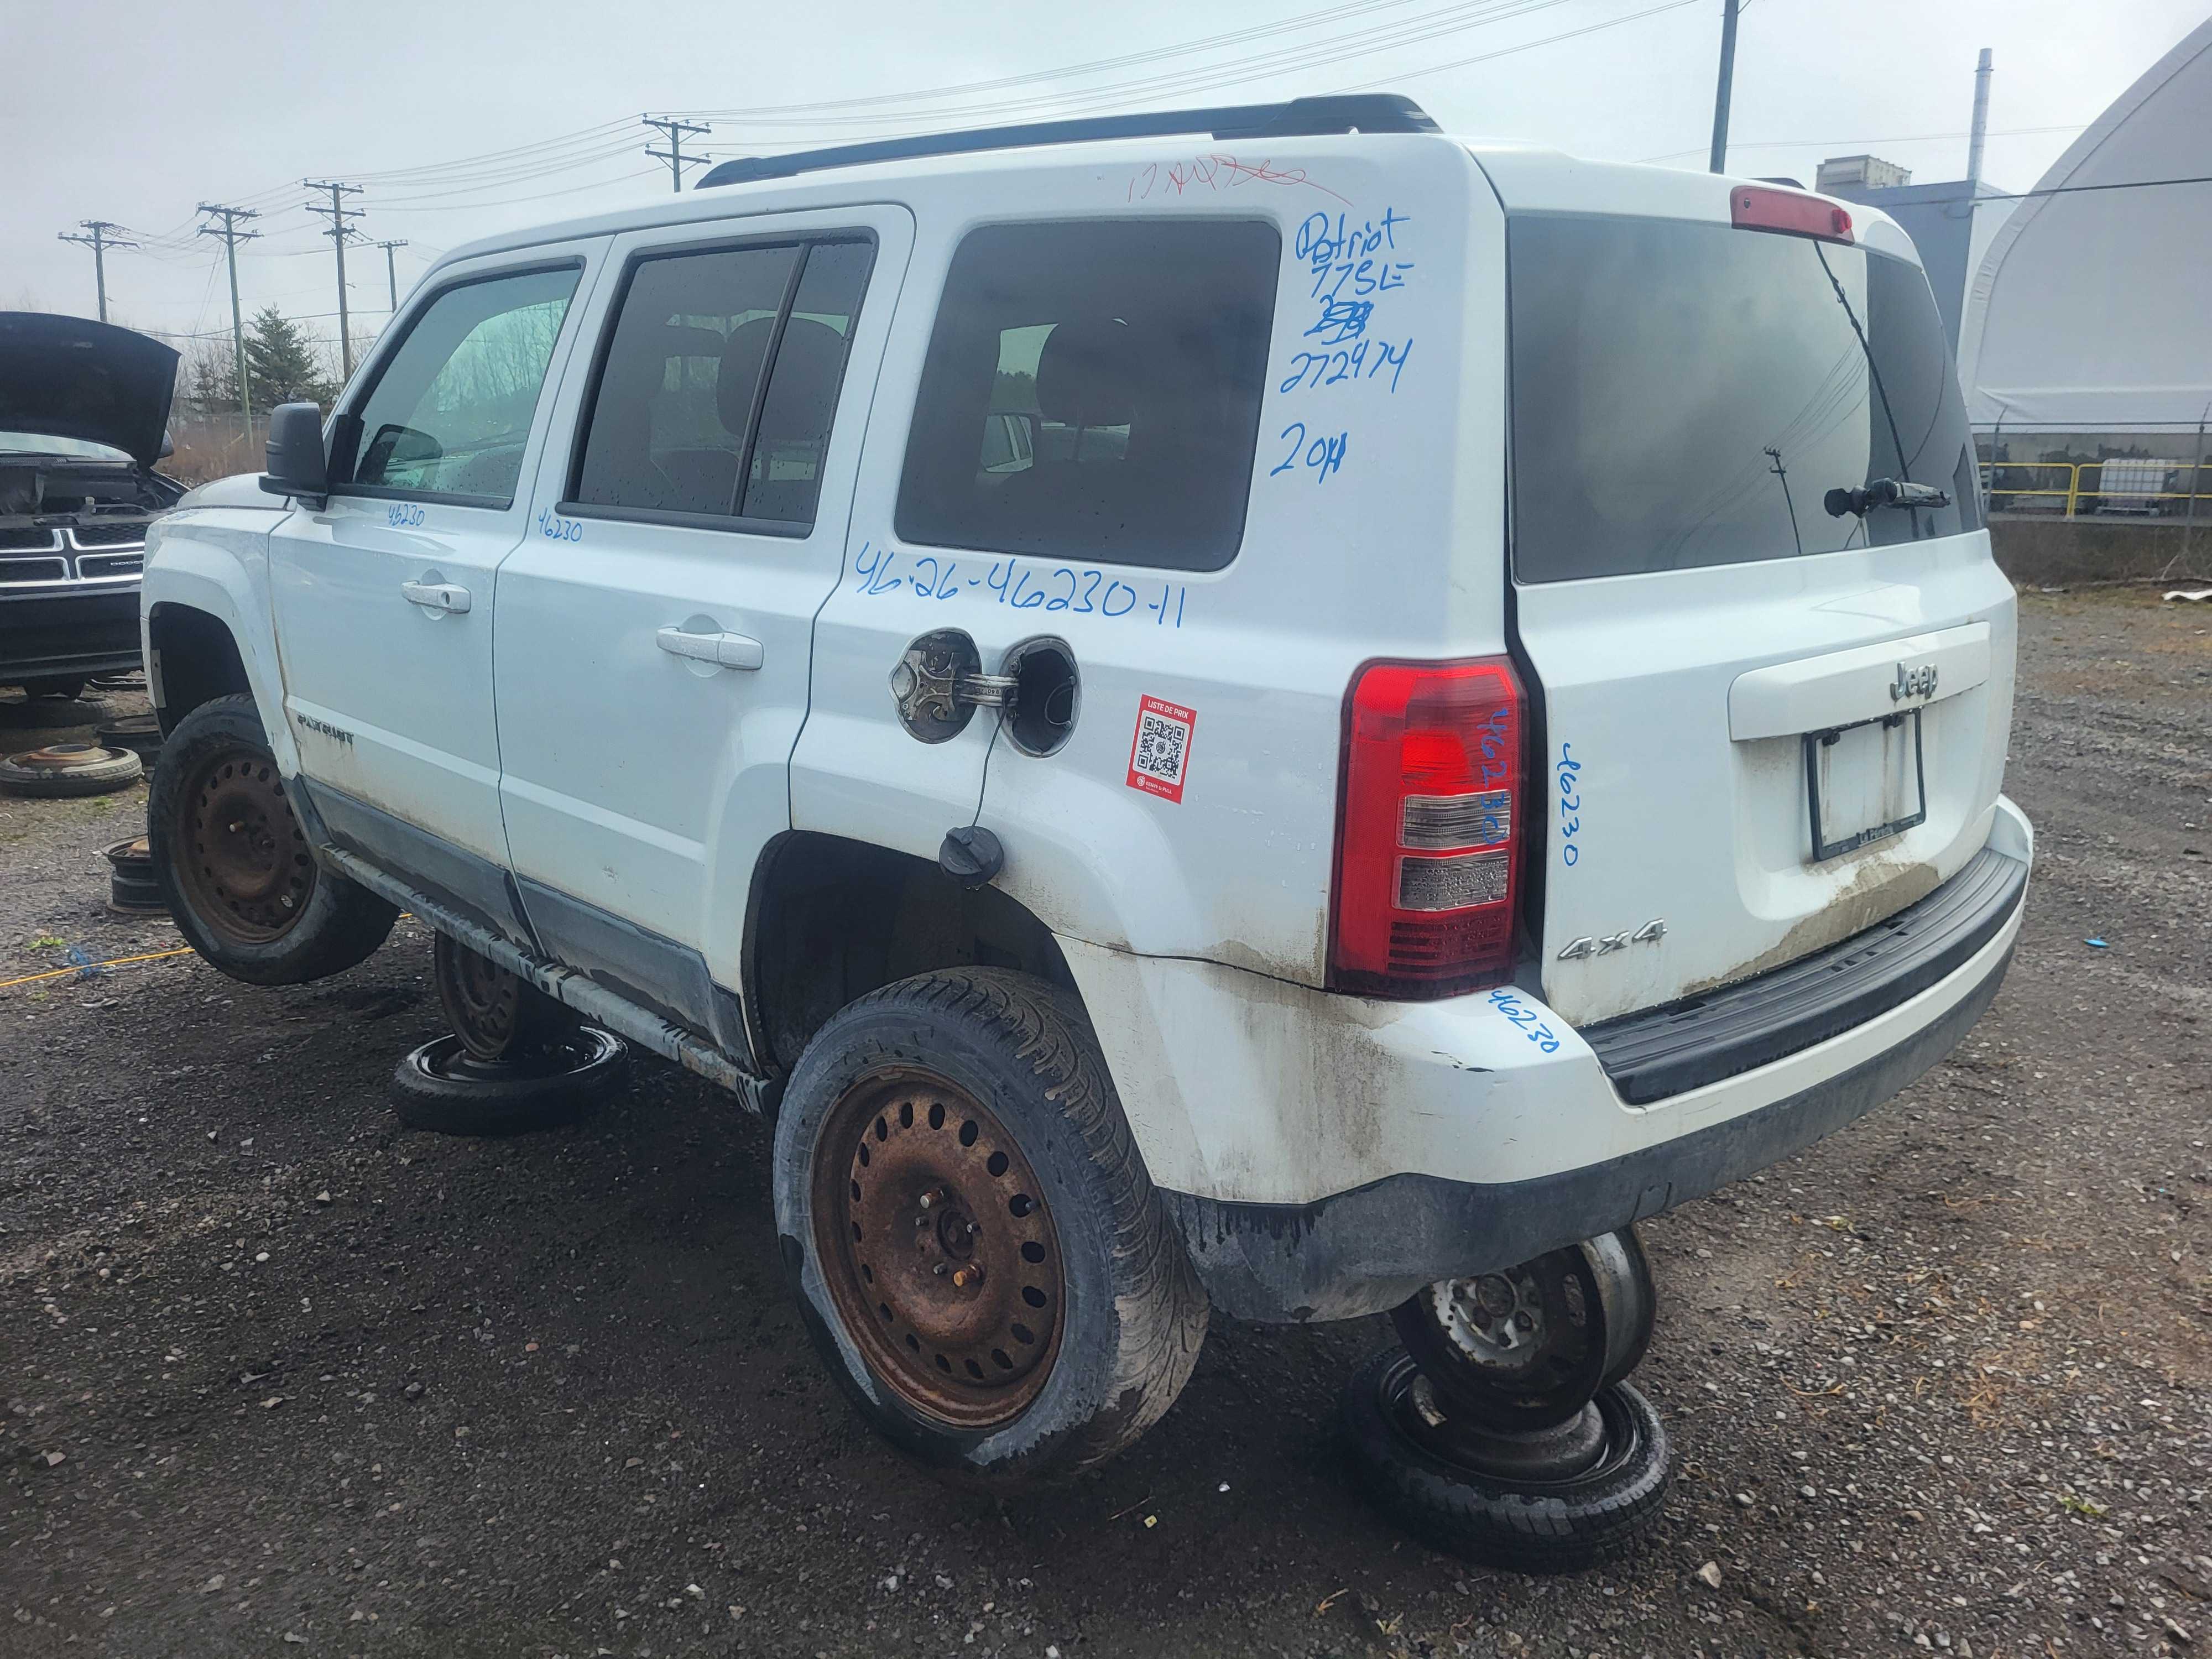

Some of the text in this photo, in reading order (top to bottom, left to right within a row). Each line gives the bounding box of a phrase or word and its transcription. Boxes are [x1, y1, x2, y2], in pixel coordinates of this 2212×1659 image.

[1296, 207, 1411, 264] Patriot
[537, 507, 583, 542] 46230
[1890, 661, 1938, 700] Jeep
[297, 712, 354, 744] PATRIOT
[1147, 699, 1189, 719] LISTE DE PRIX
[1159, 785, 1173, 795] U-PULL
[1477, 707, 1509, 845] 46230
[1557, 743, 1582, 867] 46230
[1488, 990, 1560, 1053] 46230
